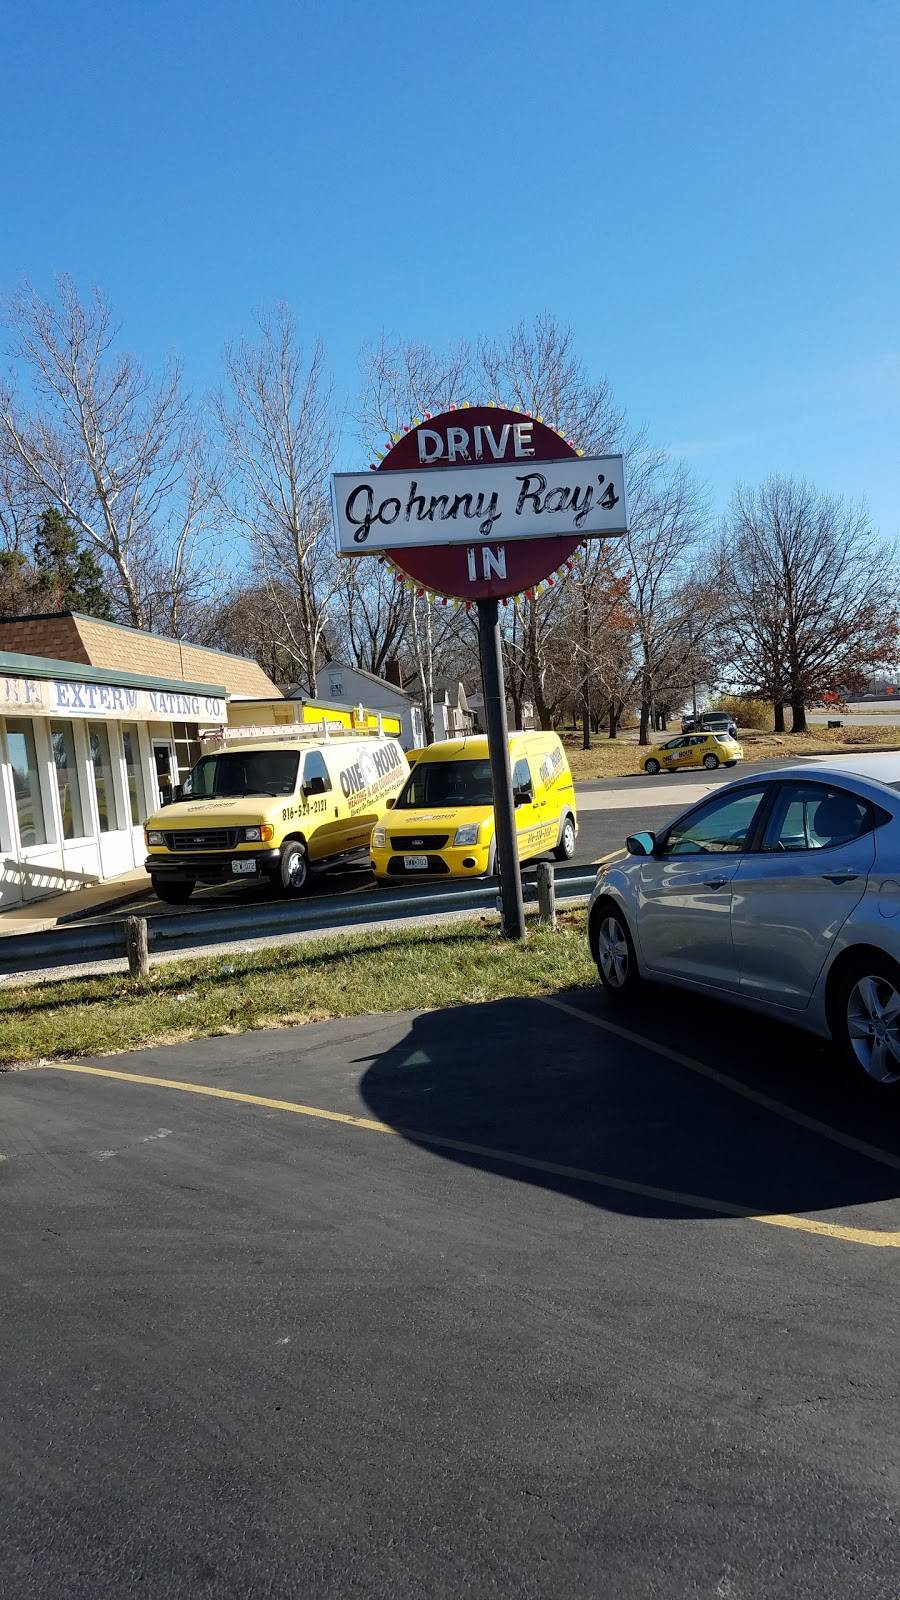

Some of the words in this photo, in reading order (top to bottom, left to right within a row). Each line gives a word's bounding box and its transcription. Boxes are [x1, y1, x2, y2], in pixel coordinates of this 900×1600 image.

[416, 422, 536, 464] DRIVE
[345, 481, 502, 543] Johnny
[515, 473, 619, 528] Ray's
[466, 546, 507, 582] IN
[56, 682, 200, 714] EXTERMNATING
[340, 763, 364, 798] ONE
[372, 743, 401, 778] HOUR
